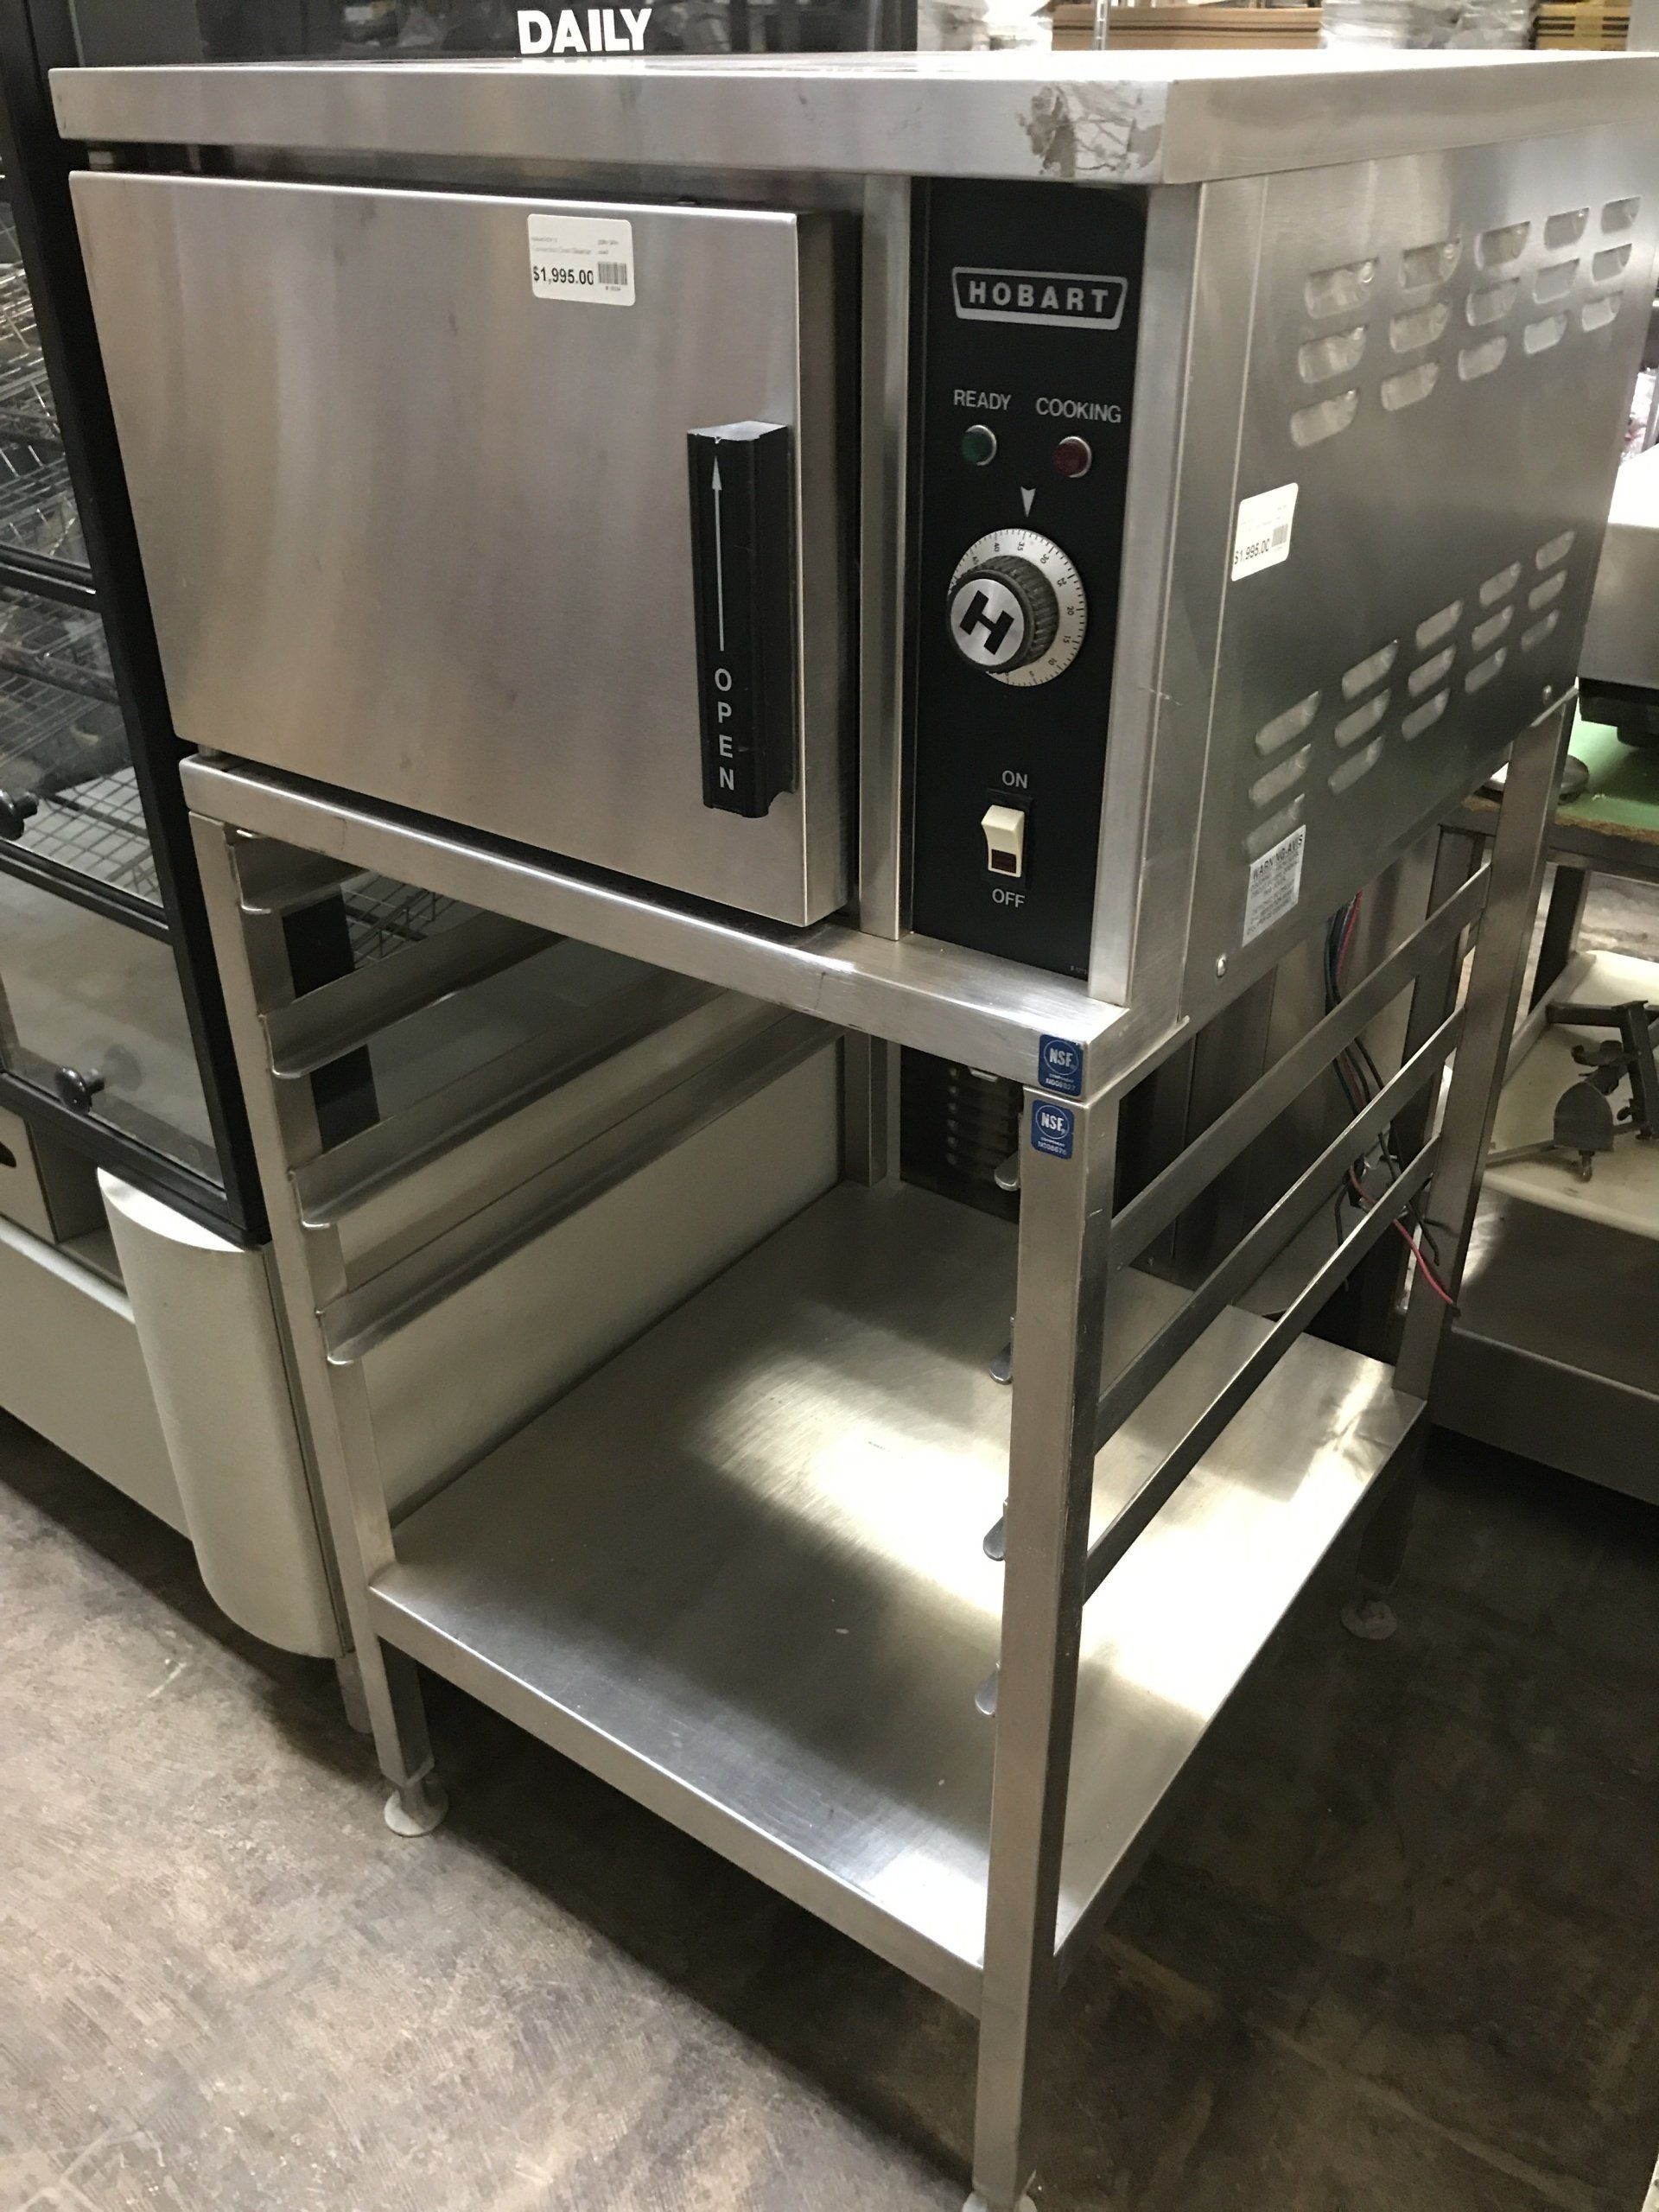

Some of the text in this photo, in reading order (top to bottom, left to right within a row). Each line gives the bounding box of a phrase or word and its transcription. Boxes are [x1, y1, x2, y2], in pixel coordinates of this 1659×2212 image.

[518, 8, 652, 54] DAILY
[533, 265, 594, 286] $1,995.00
[969, 280, 1109, 313] HOBART
[954, 389, 1012, 411] READY
[1036, 397, 1122, 423] COOKING
[959, 589, 1014, 656] H
[715, 668, 735, 791] OPEN
[1001, 770, 1028, 789] ON
[992, 888, 1026, 908] OFF
[1049, 1047, 1073, 1067] NSF
[1041, 1112, 1065, 1132] NSF
